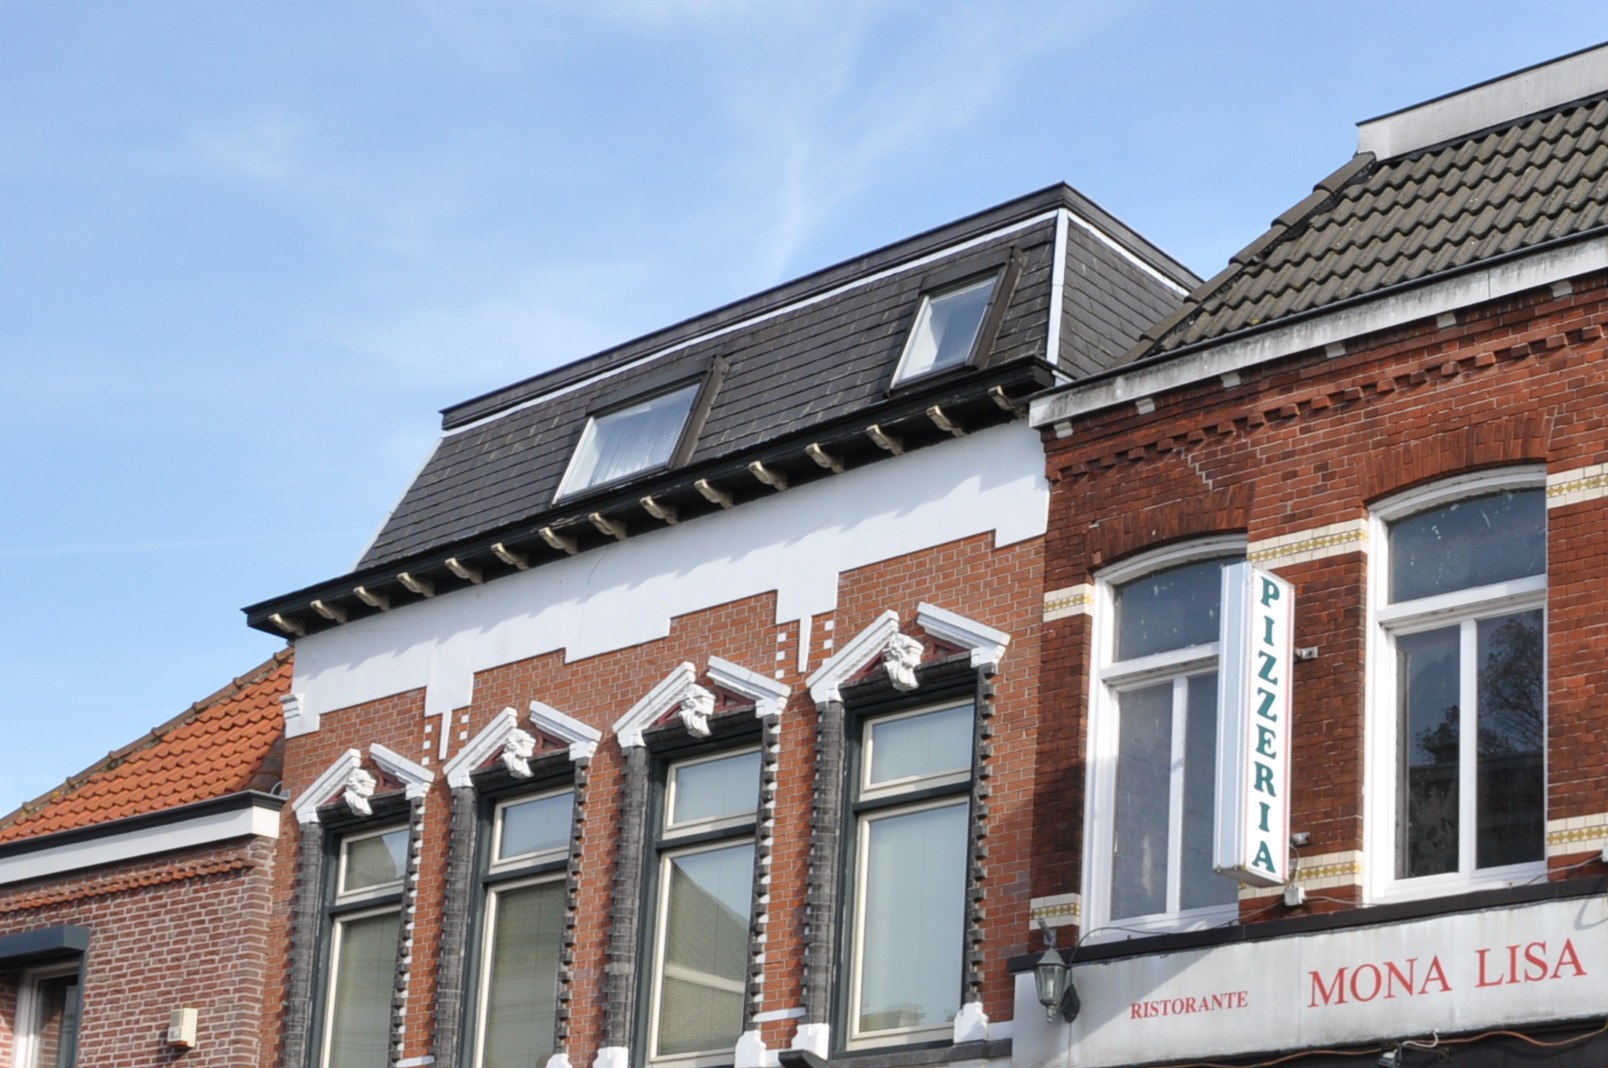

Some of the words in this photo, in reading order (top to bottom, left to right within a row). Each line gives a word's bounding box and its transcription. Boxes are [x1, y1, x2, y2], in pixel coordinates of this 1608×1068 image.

[1252, 575, 1280, 874] PIZZERIA
[1130, 990, 1249, 1020] RISTORANTE
[1307, 955, 1451, 1008] MONA
[1474, 937, 1587, 988] LISA
